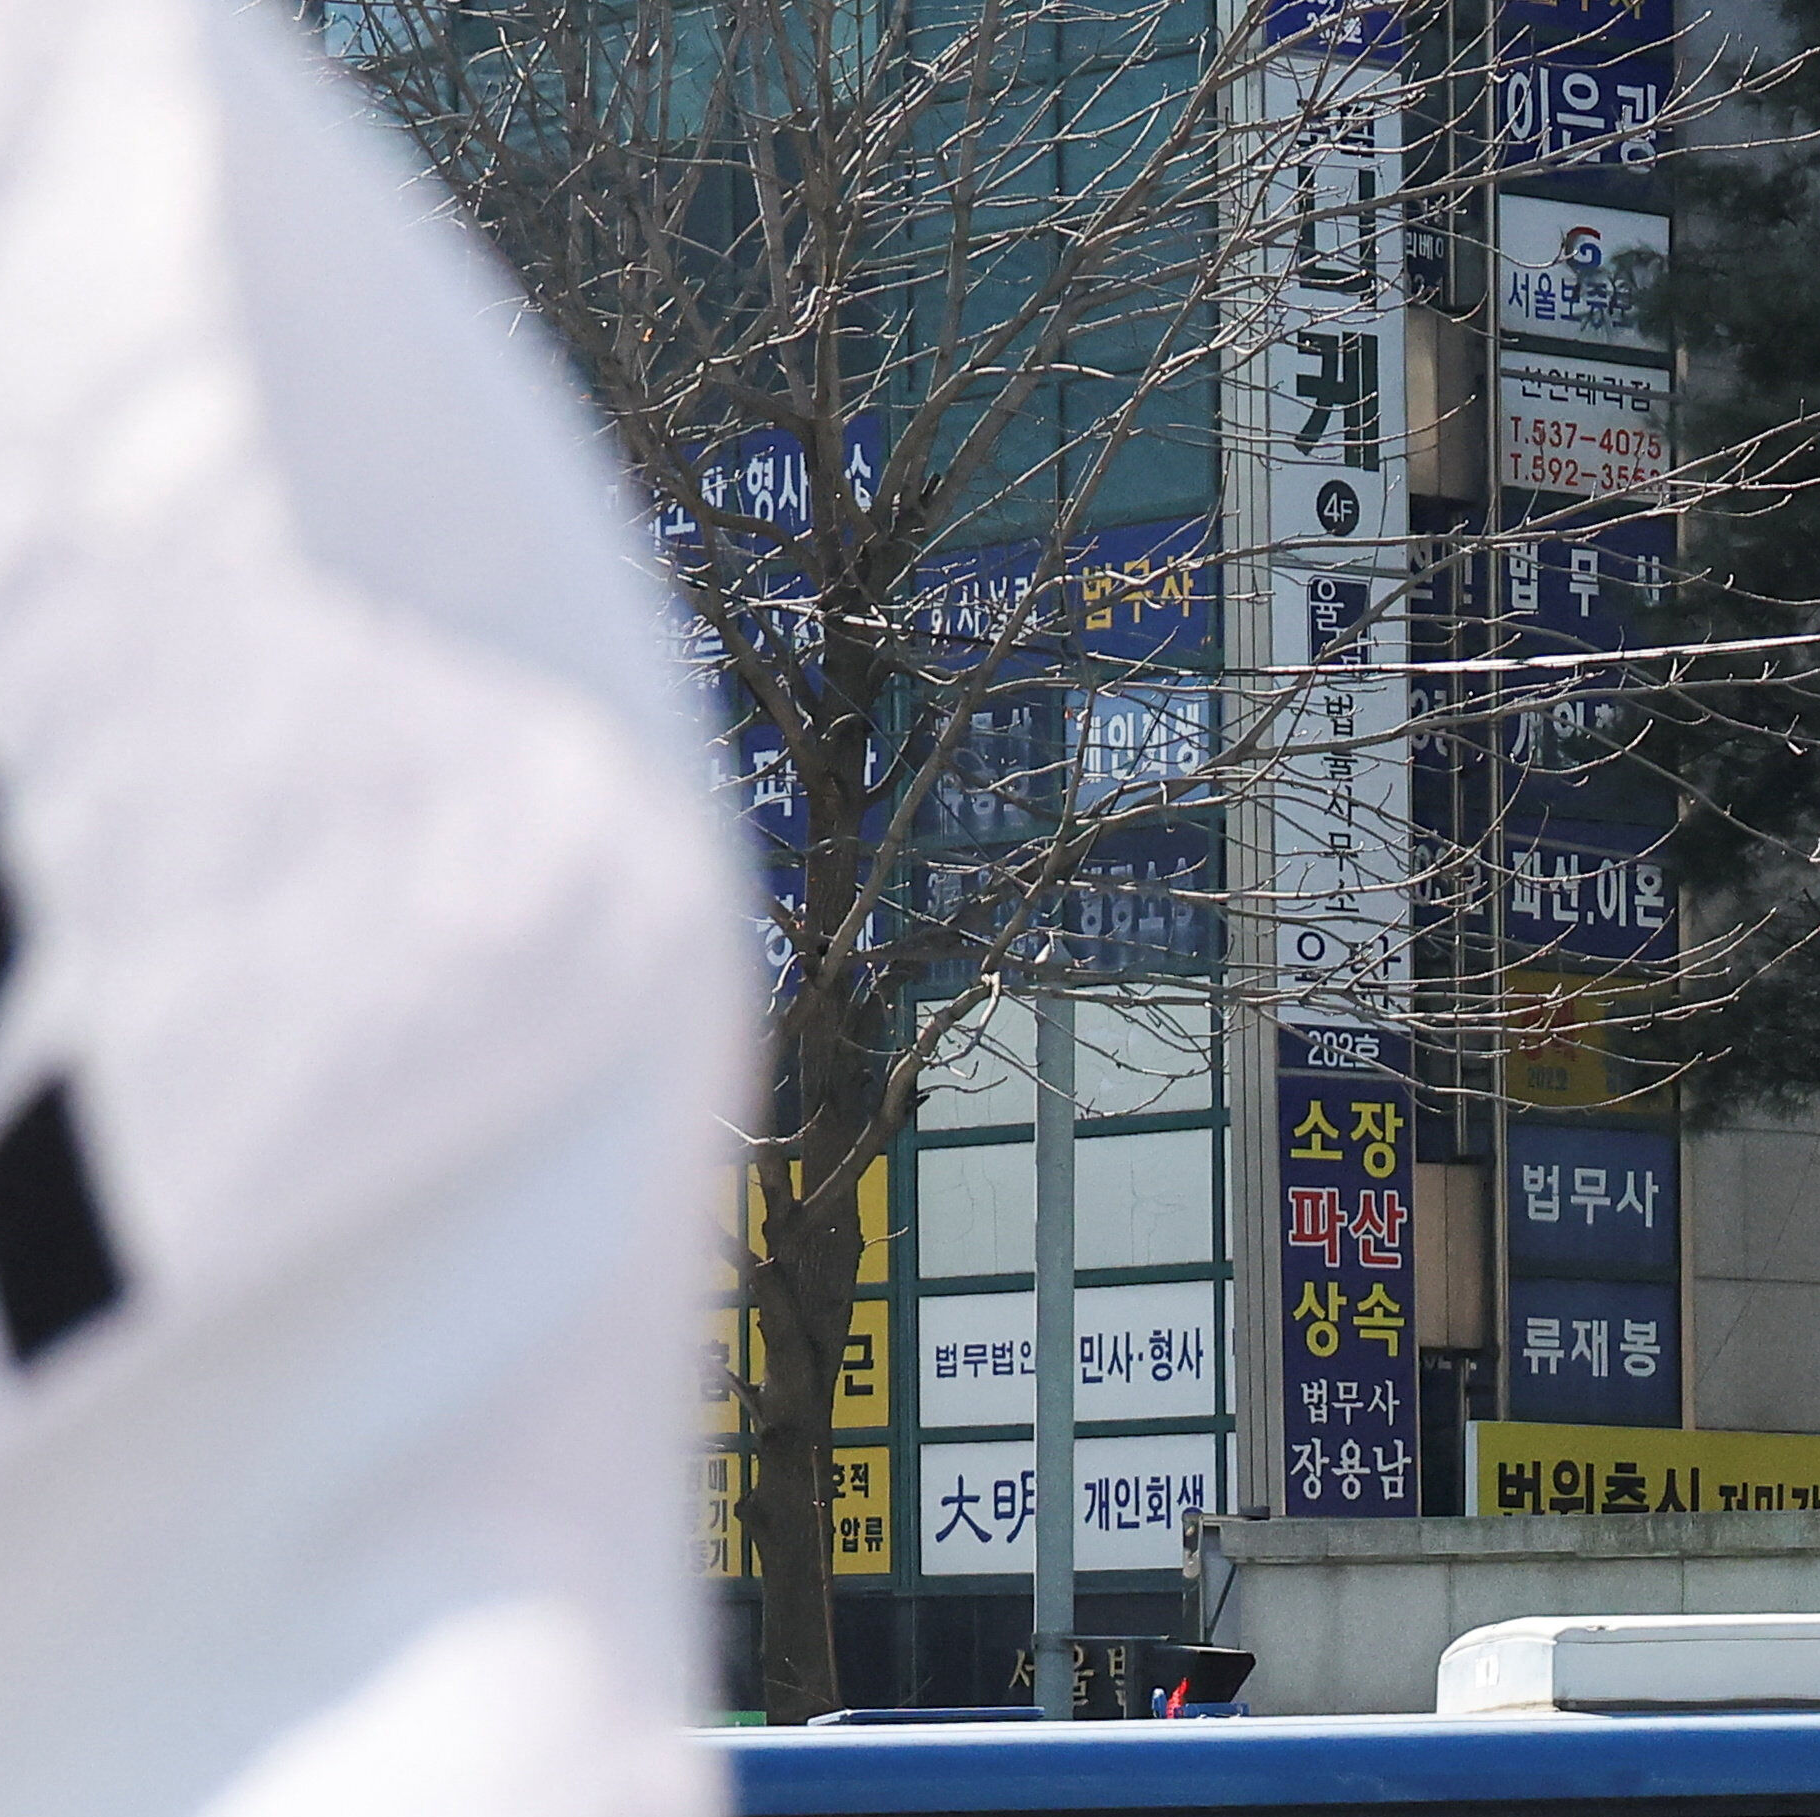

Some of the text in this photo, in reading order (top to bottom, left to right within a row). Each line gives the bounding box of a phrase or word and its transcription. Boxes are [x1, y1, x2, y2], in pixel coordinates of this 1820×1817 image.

[1510, 416, 1662, 460] T.537-4075
[1323, 490, 1354, 521] 4F
[1307, 1029, 1381, 1068] 202호
[1289, 1099, 1405, 1180] 소장
[1522, 1163, 1660, 1229] 법무사
[1288, 1186, 1408, 1269] 파산
[1292, 1281, 1406, 1360] 상속
[1522, 1317, 1662, 1378] 류재봉
[1300, 1378, 1401, 1427] 법무사
[1290, 1437, 1412, 1501] 장용남
